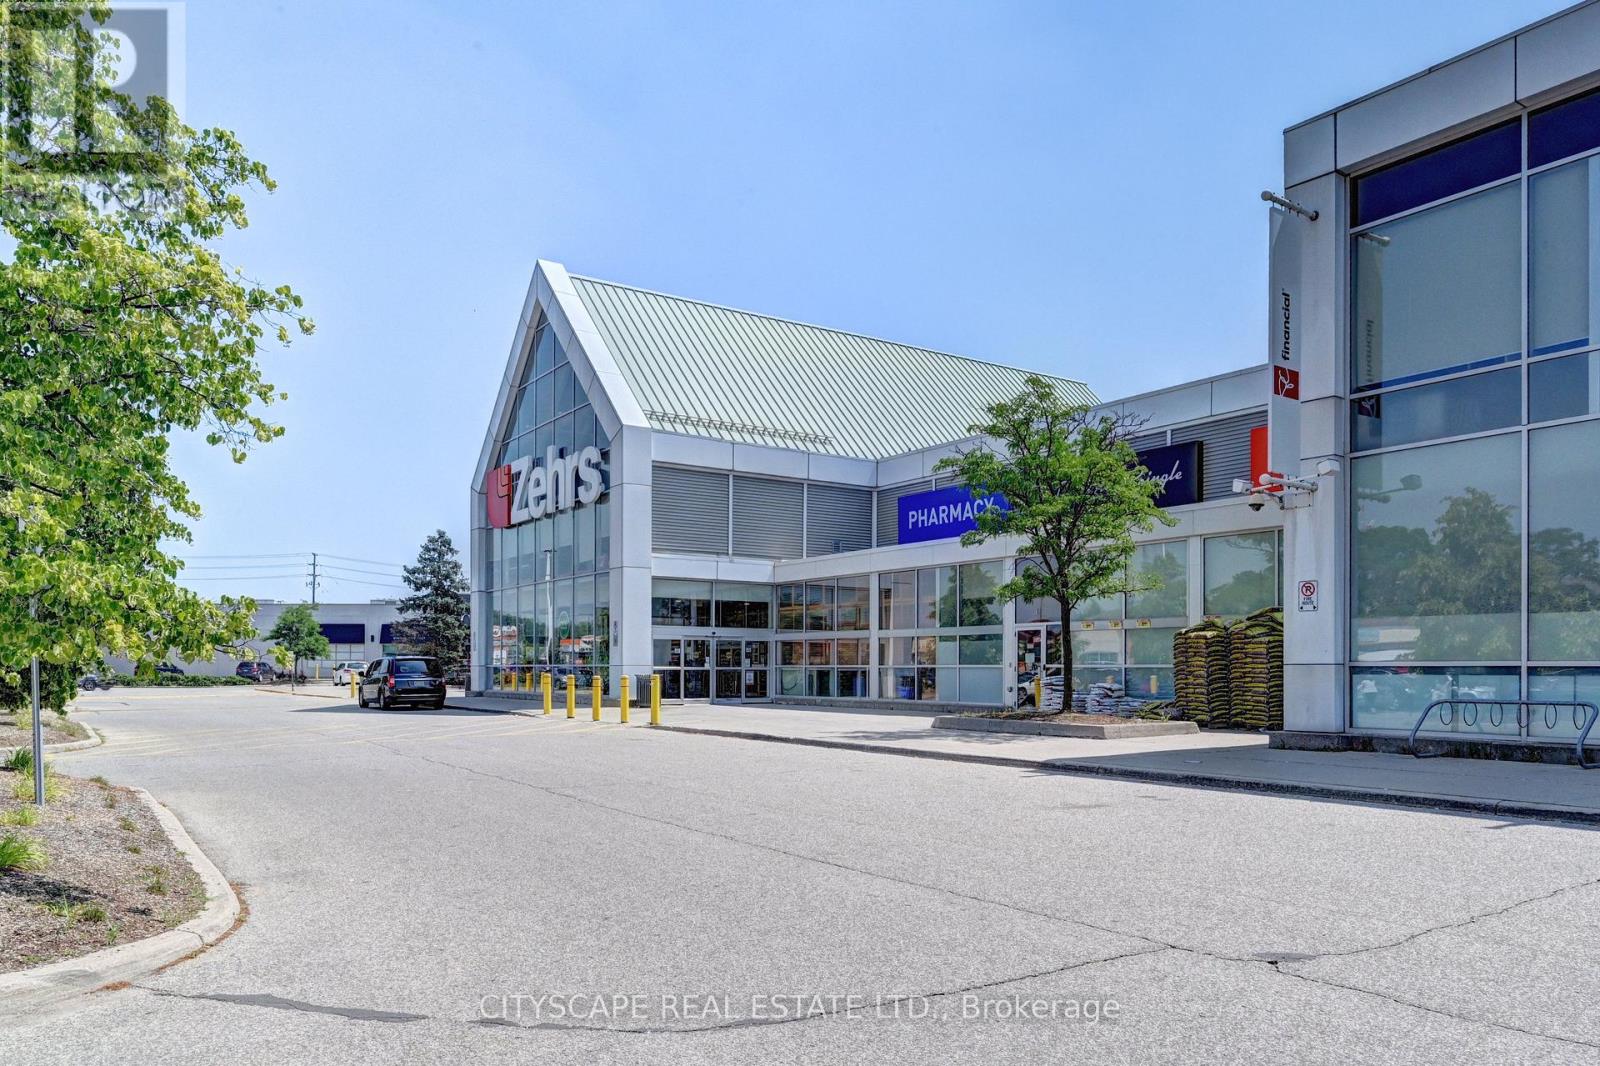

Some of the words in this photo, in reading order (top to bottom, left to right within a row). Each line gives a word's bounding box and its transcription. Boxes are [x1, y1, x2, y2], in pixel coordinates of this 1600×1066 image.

[1282, 291, 1291, 361] financial
[510, 445, 603, 525] Zehrs
[908, 497, 994, 529] PHARMACY
